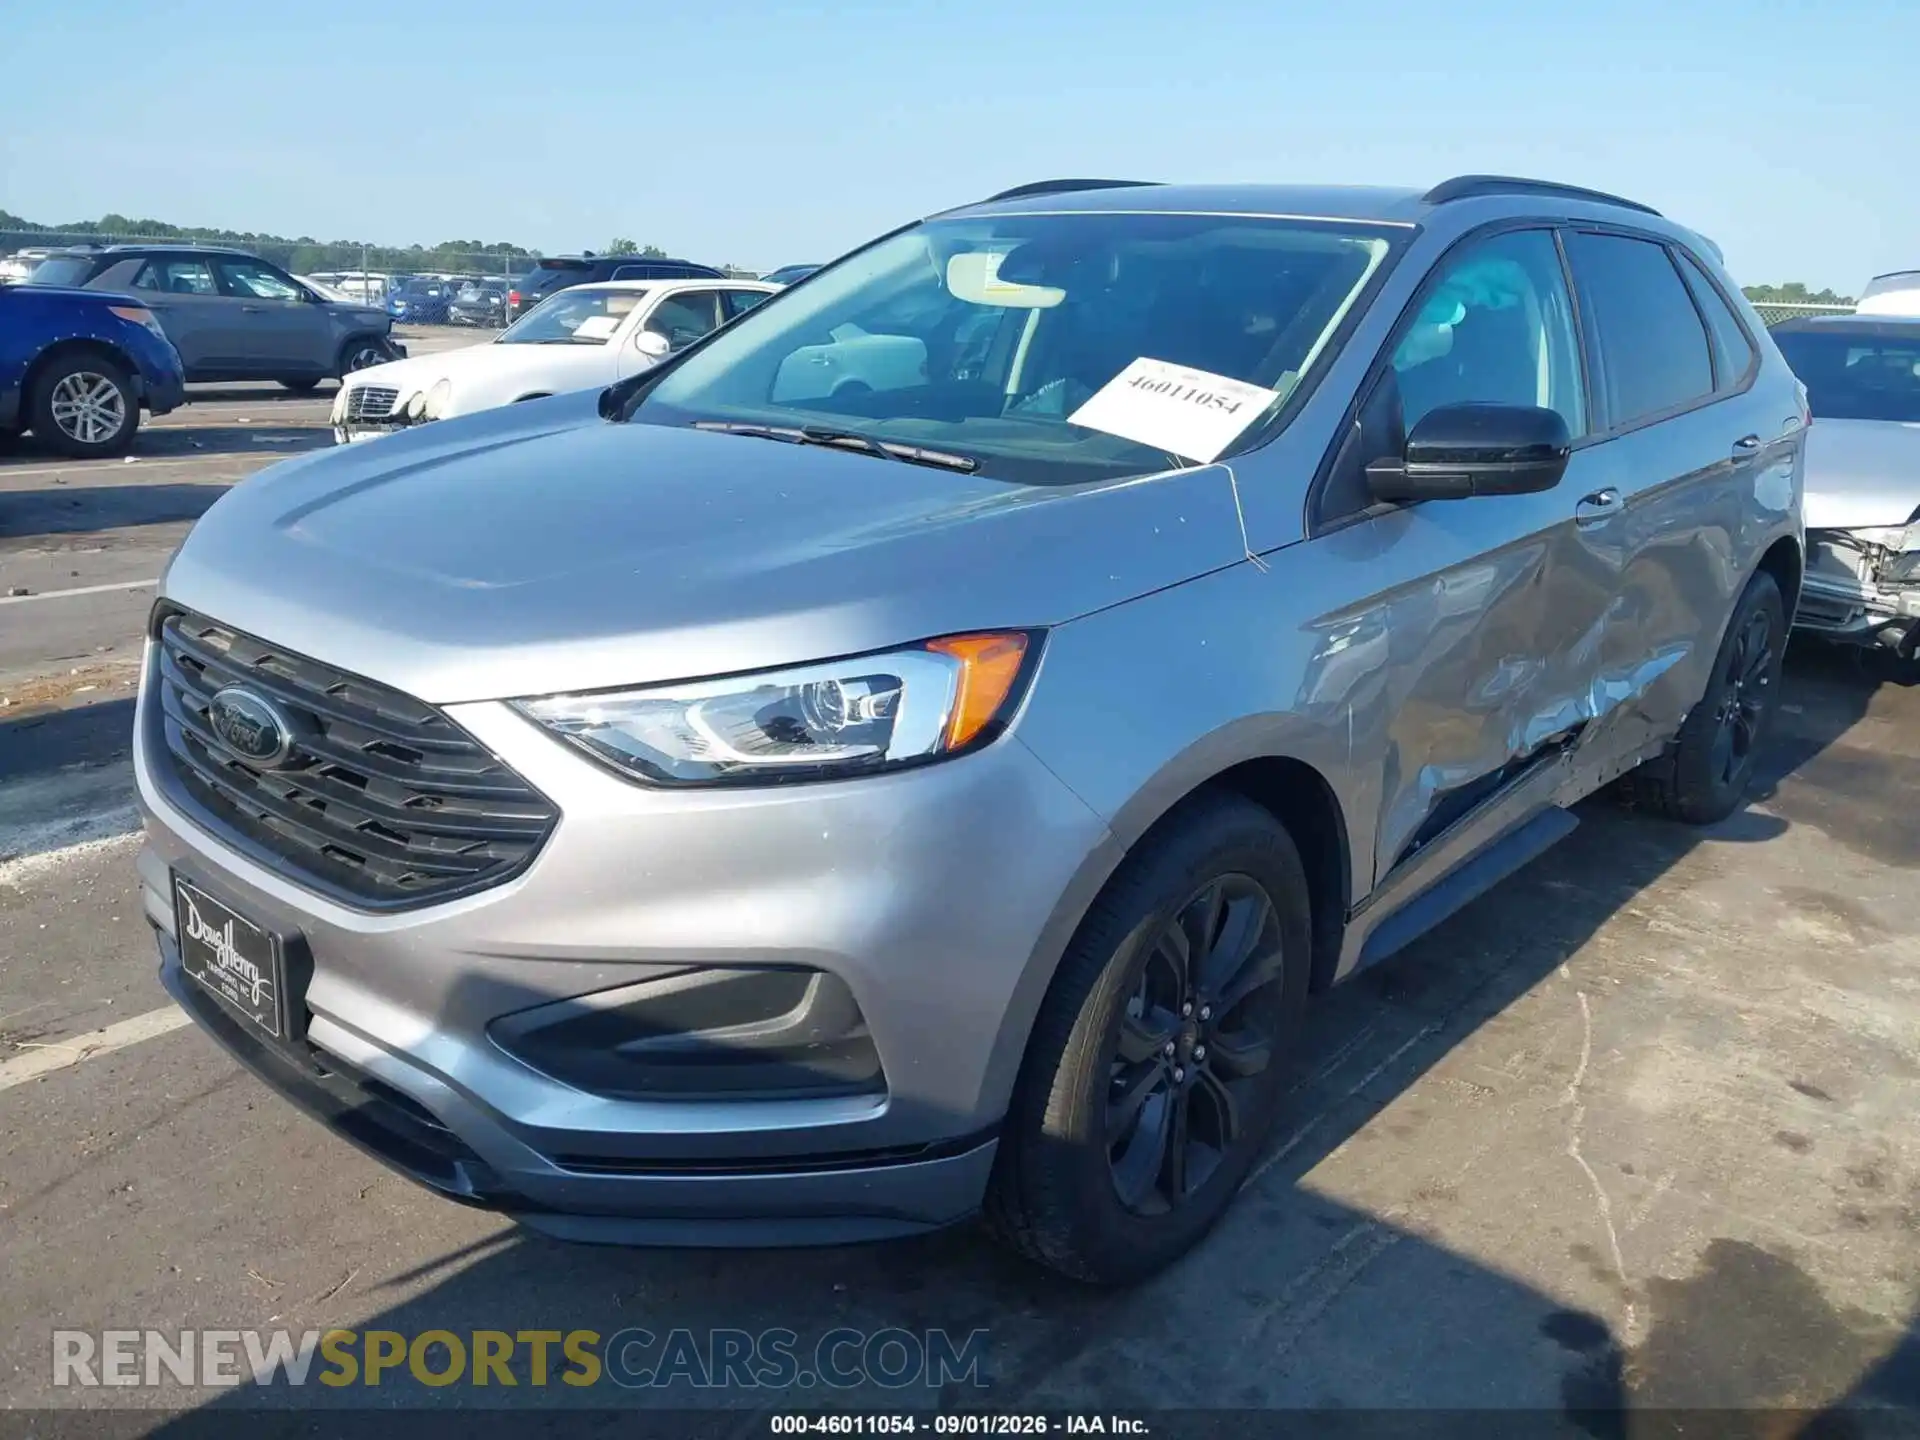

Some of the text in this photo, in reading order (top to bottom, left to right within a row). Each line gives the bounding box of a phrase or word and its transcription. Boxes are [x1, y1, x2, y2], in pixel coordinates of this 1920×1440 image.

[1128, 375, 1243, 415] 46011054
[178, 886, 272, 1007] Doug Henry
